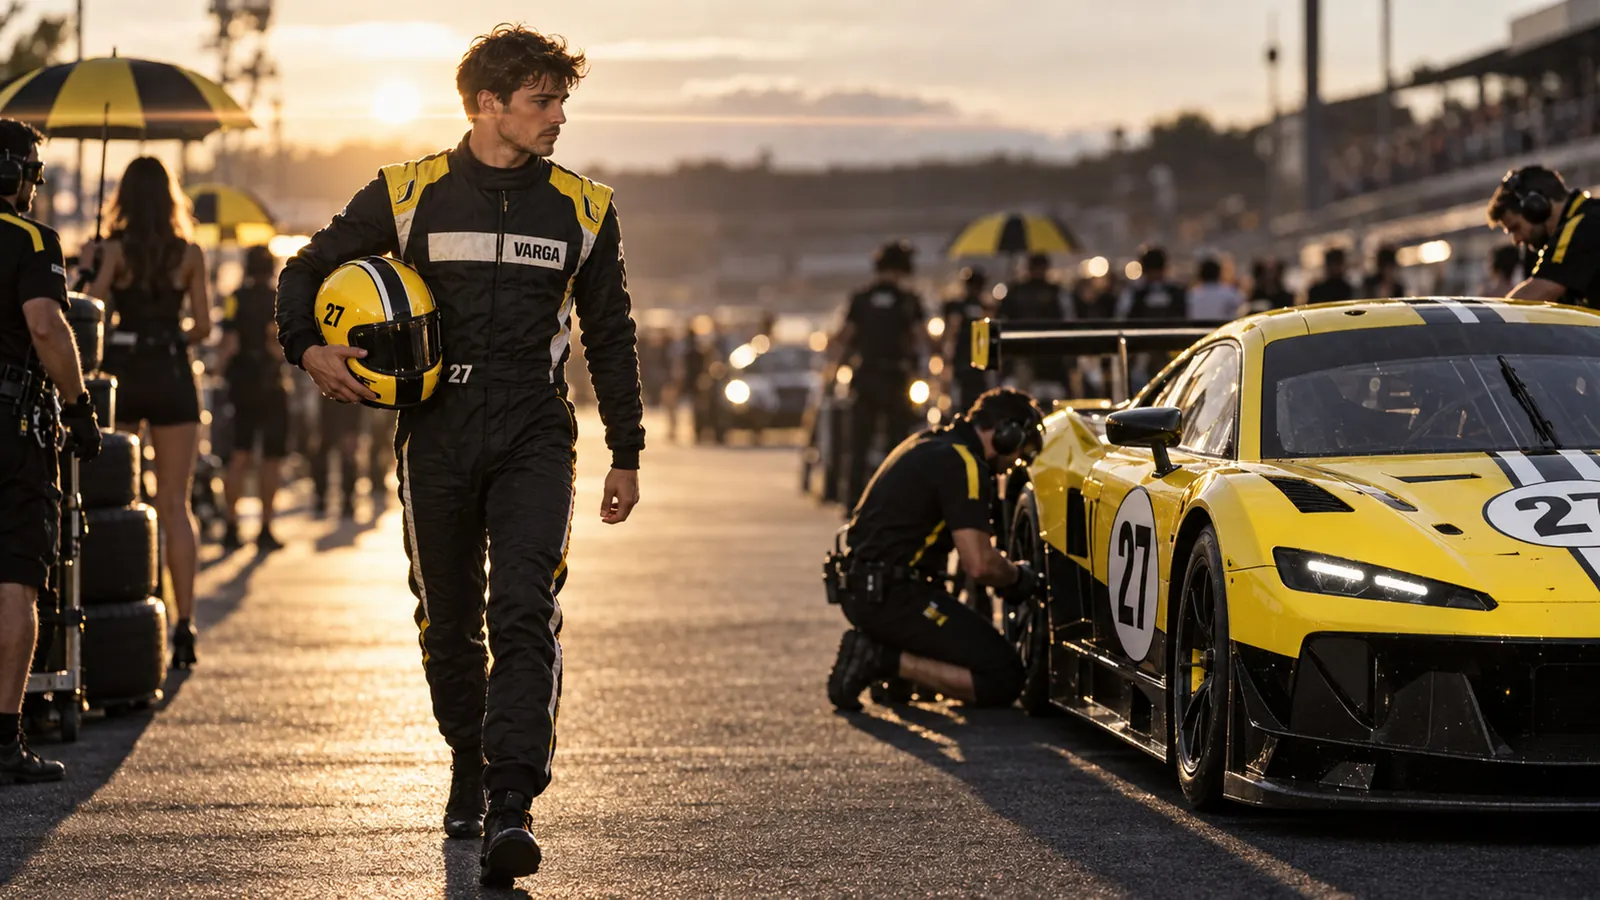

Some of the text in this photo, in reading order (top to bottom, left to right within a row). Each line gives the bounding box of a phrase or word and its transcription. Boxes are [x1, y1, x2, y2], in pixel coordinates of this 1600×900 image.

[514, 241, 560, 263] VARGA
[323, 302, 345, 328] 27
[448, 364, 473, 384] 27
[1118, 520, 1151, 630] 27
